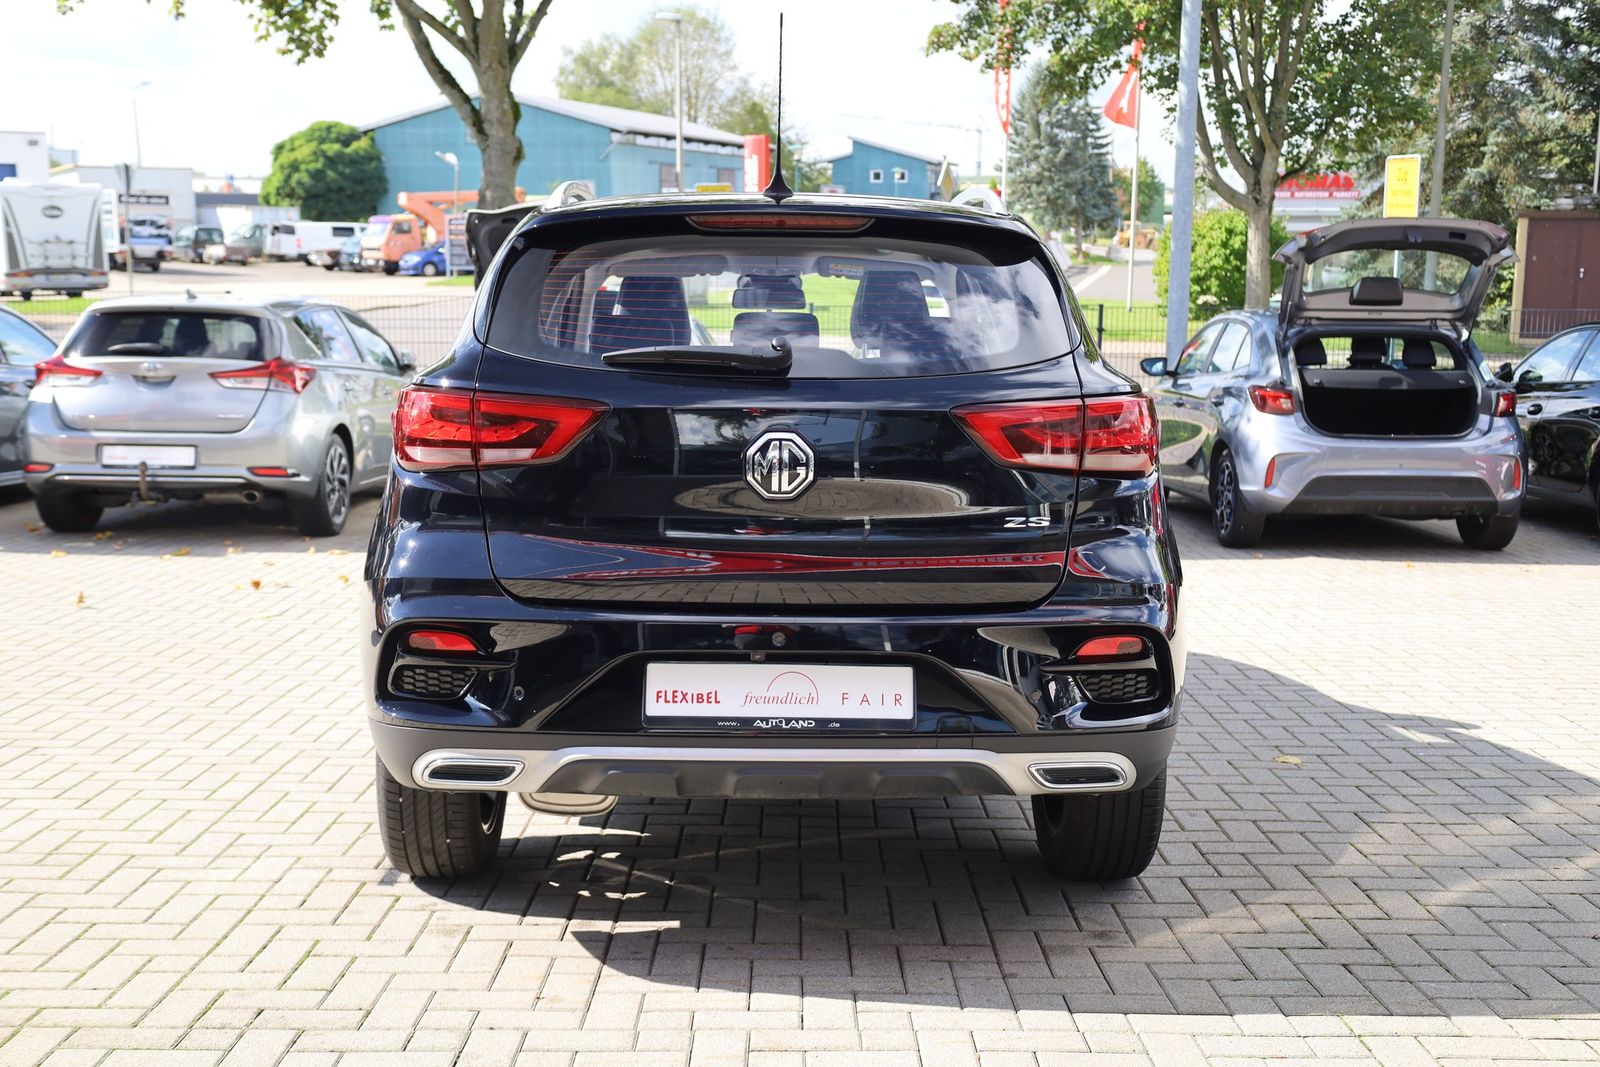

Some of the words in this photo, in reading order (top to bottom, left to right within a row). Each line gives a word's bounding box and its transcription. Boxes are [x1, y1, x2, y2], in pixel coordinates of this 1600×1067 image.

[754, 440, 806, 492] MG
[1003, 516, 1051, 528] ZS
[655, 689, 721, 704] FLEXIBEL
[740, 691, 815, 708] freundlich
[753, 718, 816, 729] AUTOLAND
